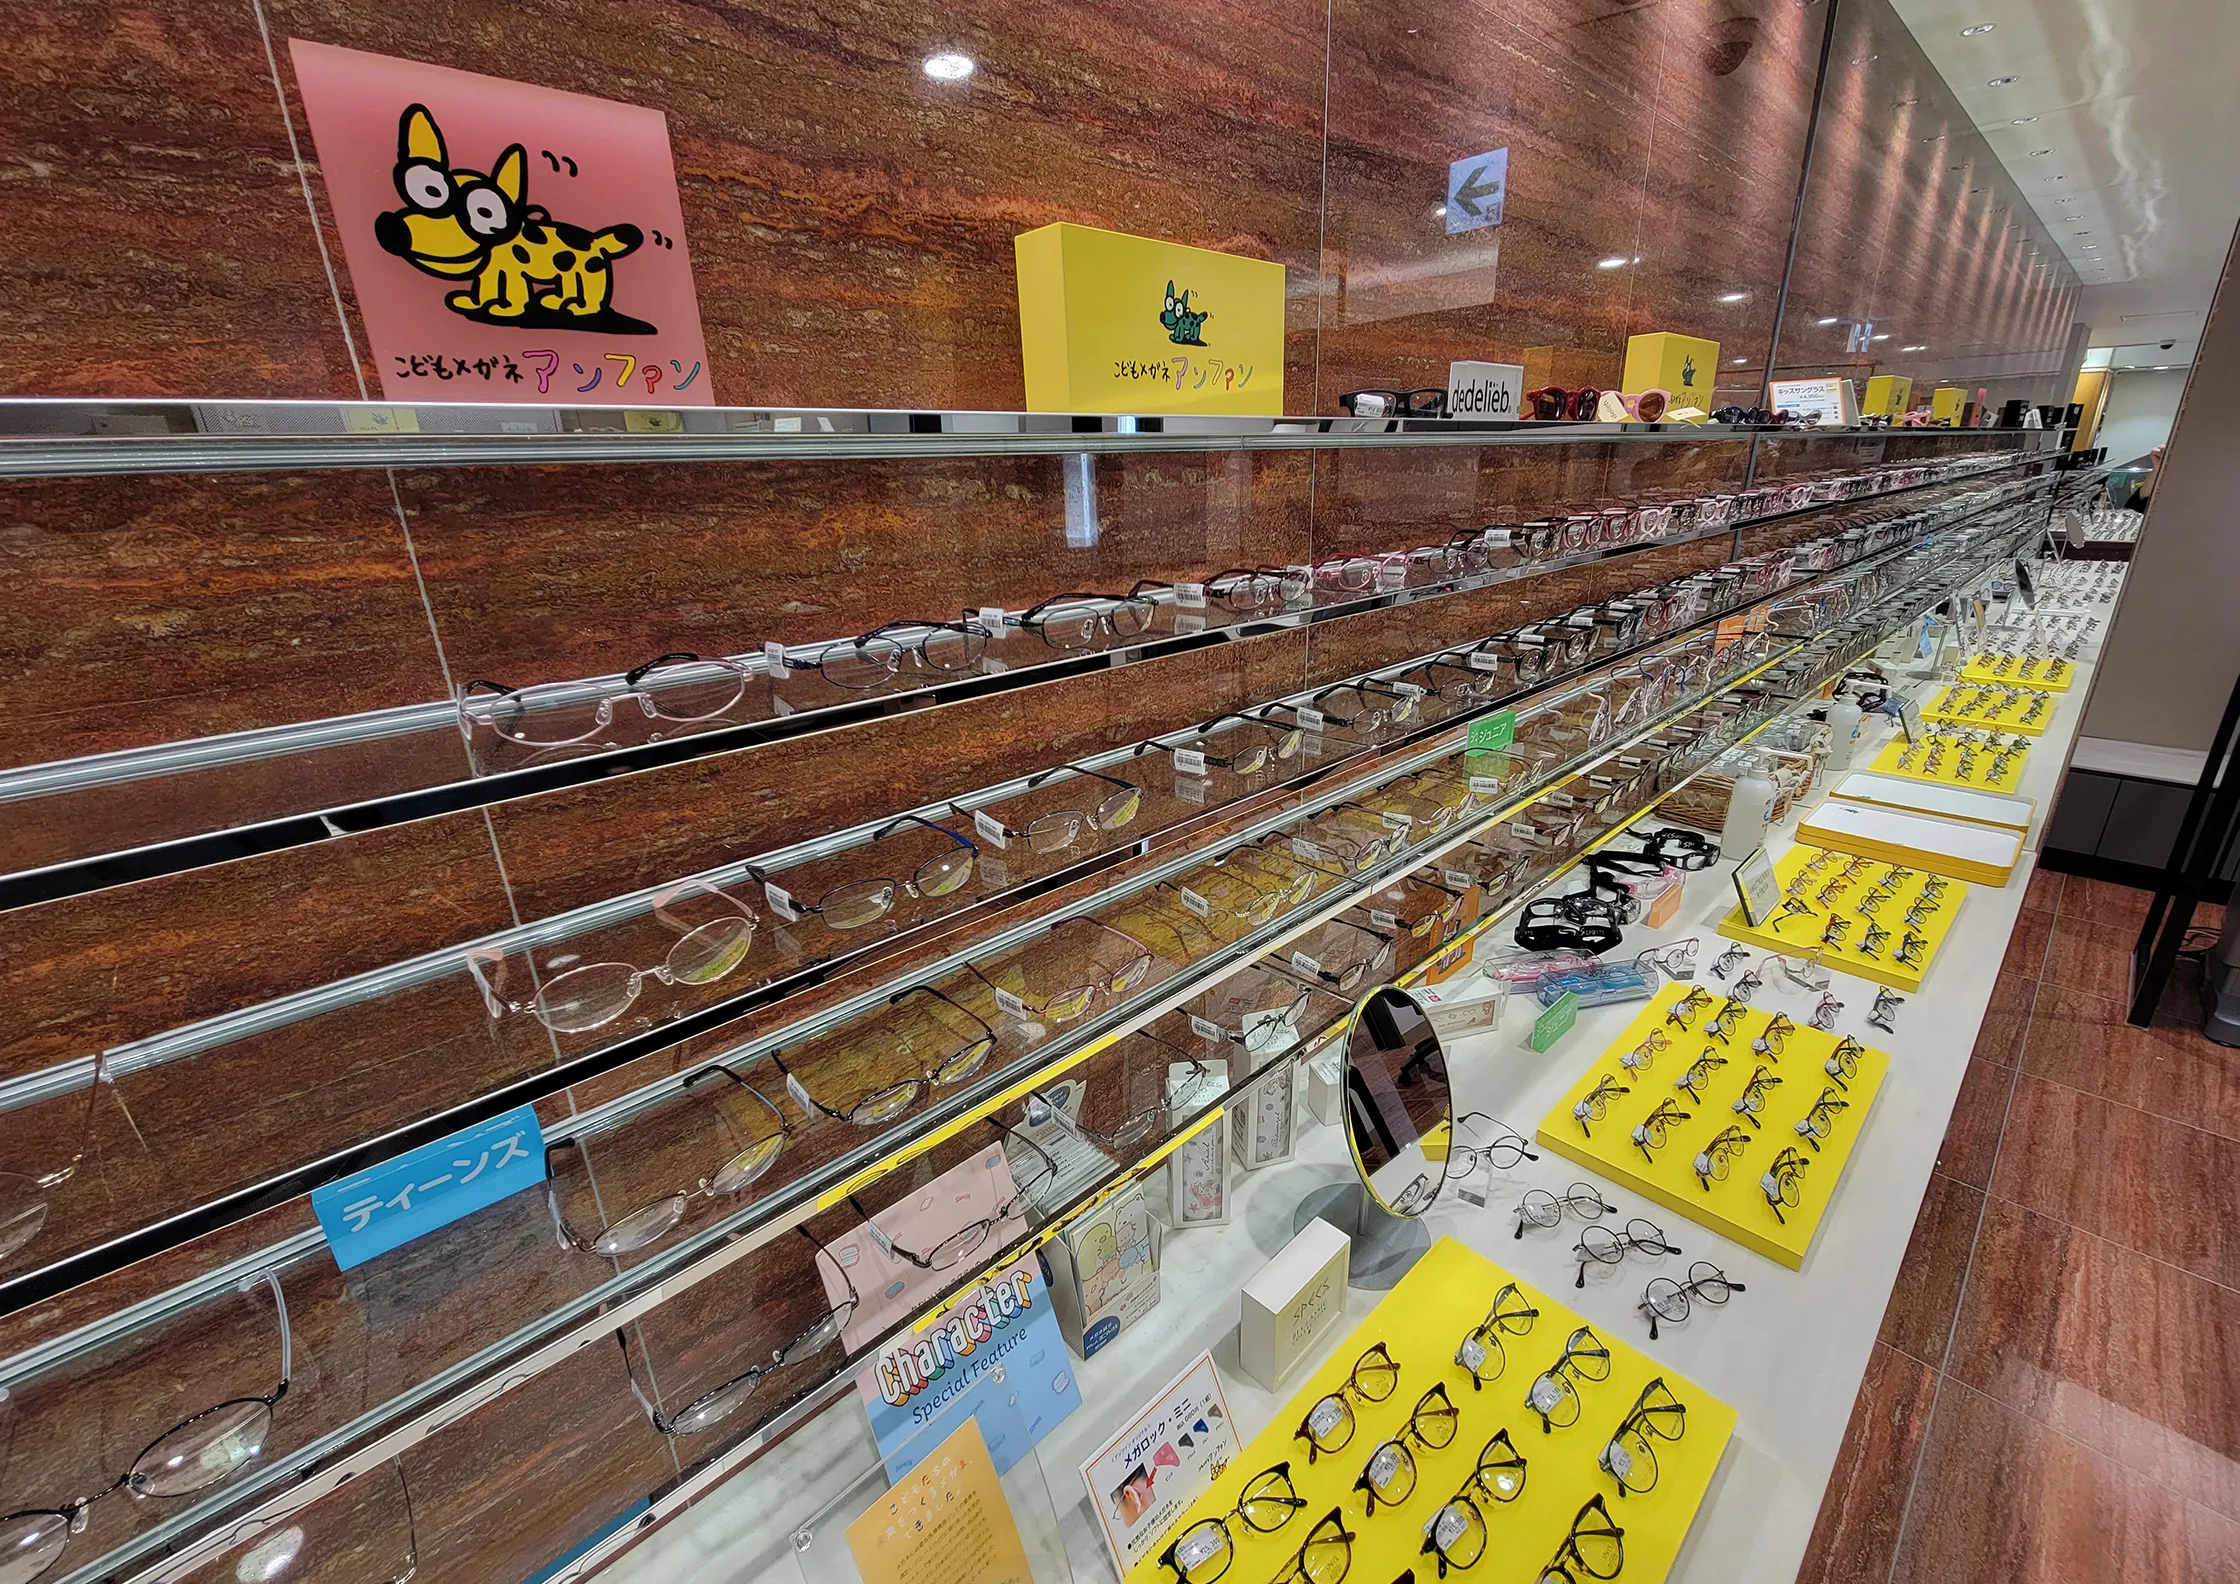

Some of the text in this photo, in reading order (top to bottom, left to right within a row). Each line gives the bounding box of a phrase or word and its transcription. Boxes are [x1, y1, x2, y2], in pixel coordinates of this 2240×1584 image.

[395, 349, 700, 394] こどもメガネアンファン
[1113, 356, 1254, 392] こどもメガネアンファン
[1777, 386, 1825, 395] キッズサングラス
[342, 1130, 530, 1233] ティーンズ
[874, 1270, 1033, 1407] Character
[912, 1328, 1027, 1424] Special Feature
[1124, 1398, 1192, 1469] メガロック・ミニ
[889, 1456, 950, 1515] こどもたちの
[903, 1489, 961, 1540] できました。
